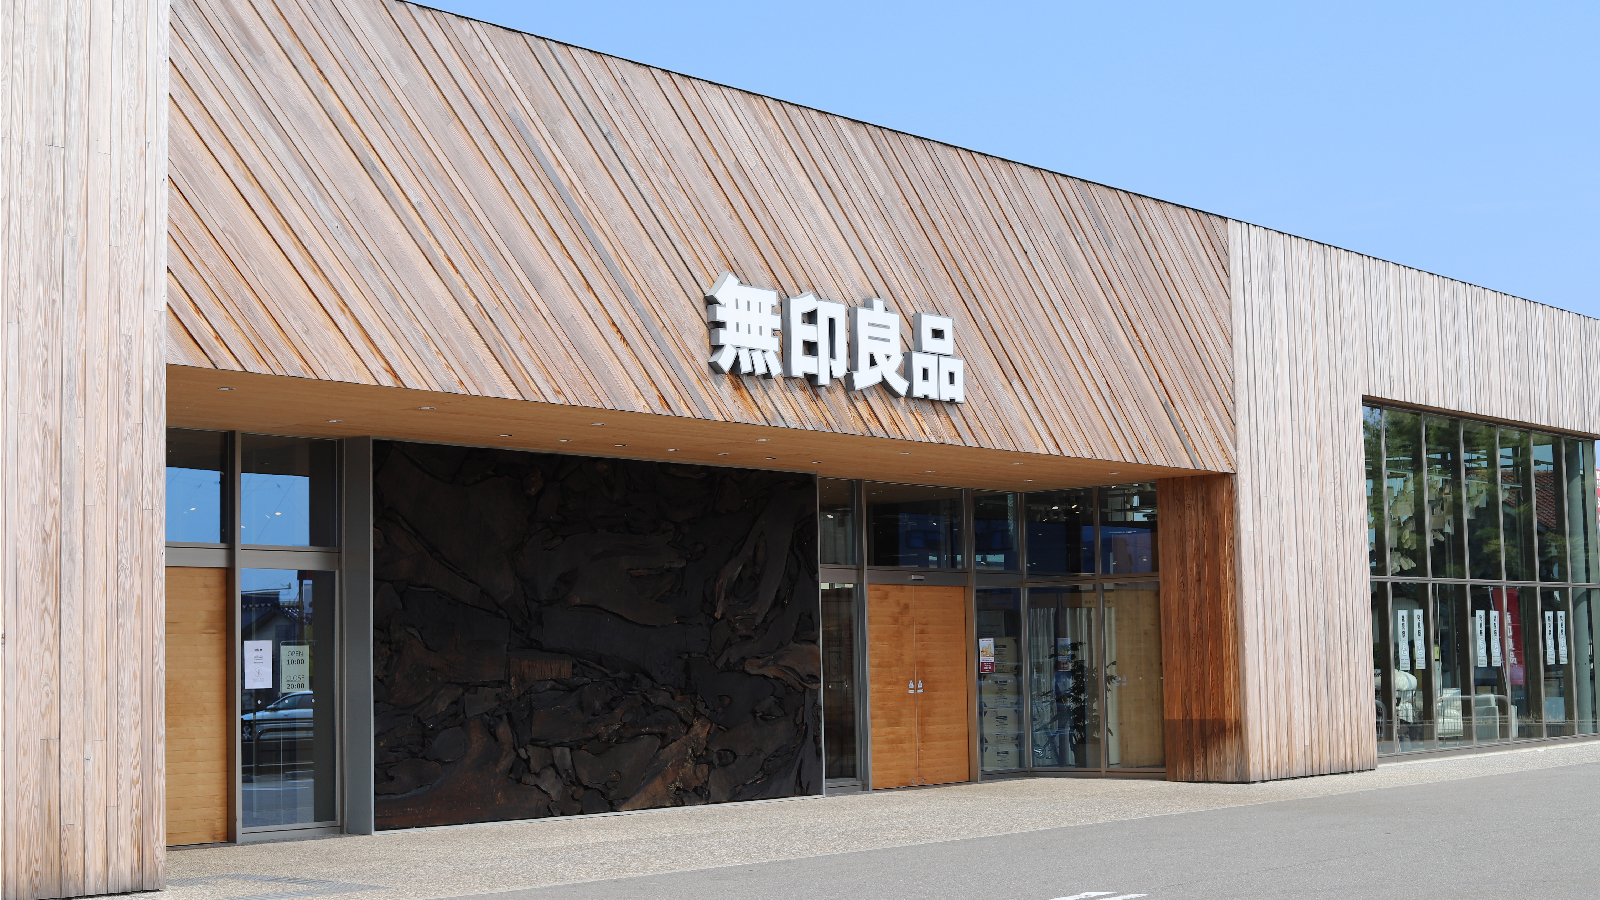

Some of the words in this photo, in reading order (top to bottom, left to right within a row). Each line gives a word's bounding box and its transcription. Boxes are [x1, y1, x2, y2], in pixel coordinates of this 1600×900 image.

[705, 271, 966, 404] 無印良品
[286, 674, 305, 682] CLOSE
